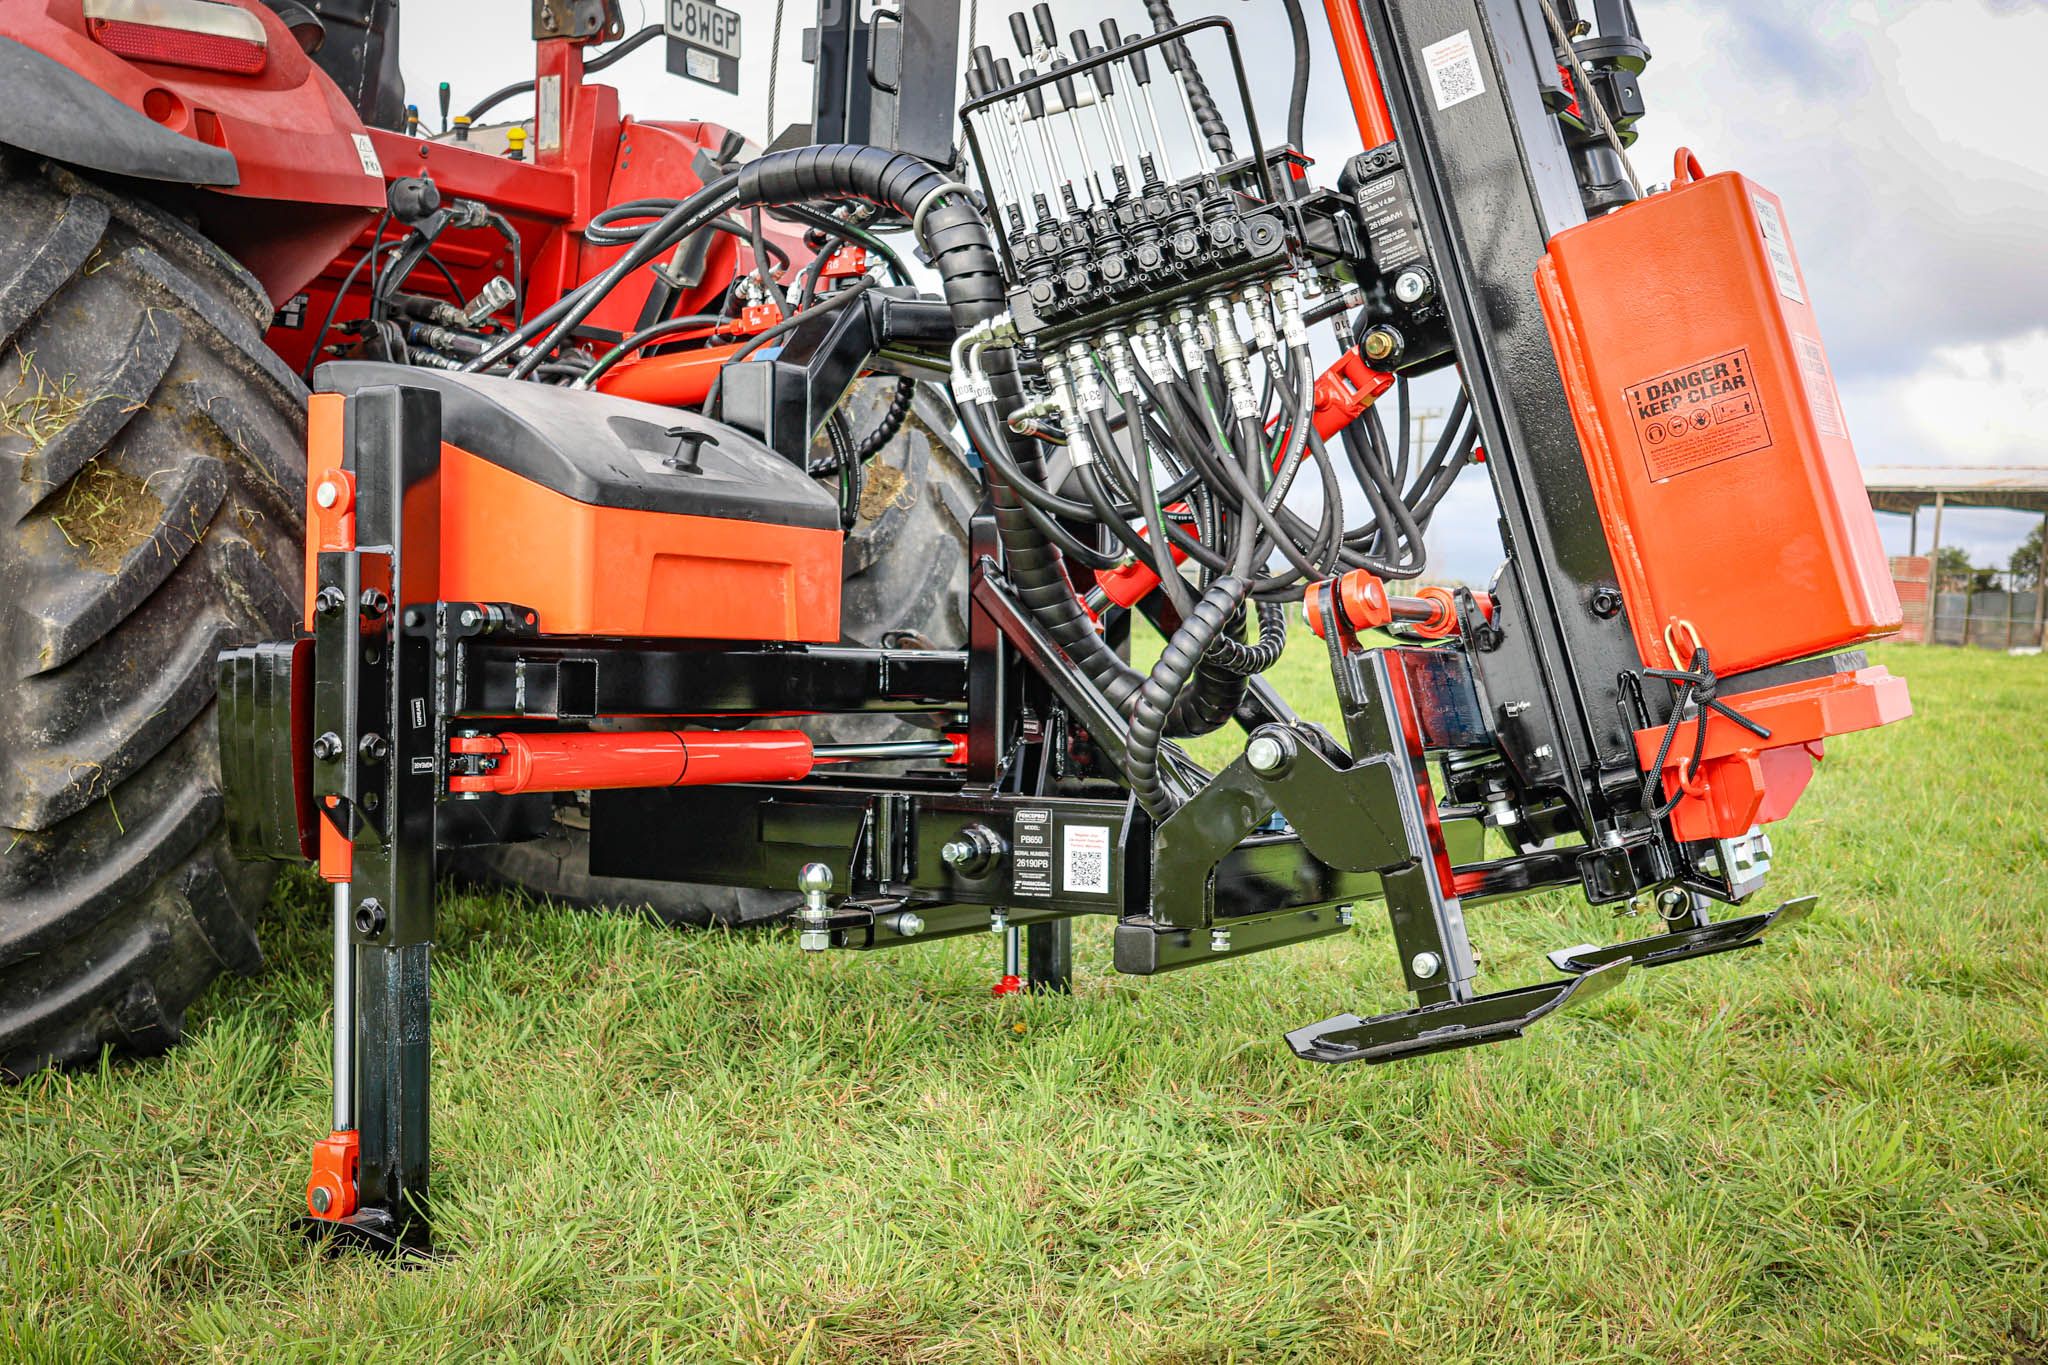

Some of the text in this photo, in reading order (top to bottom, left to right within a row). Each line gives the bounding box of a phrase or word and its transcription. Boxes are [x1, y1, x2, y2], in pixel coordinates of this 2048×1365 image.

[671, 0, 737, 49] C8WGP
[1638, 374, 1747, 421] KEEP CLEAR
[1646, 362, 1729, 401] DANGER
[1020, 835, 1044, 845] PB650
[1016, 858, 1049, 869] 26190PB
